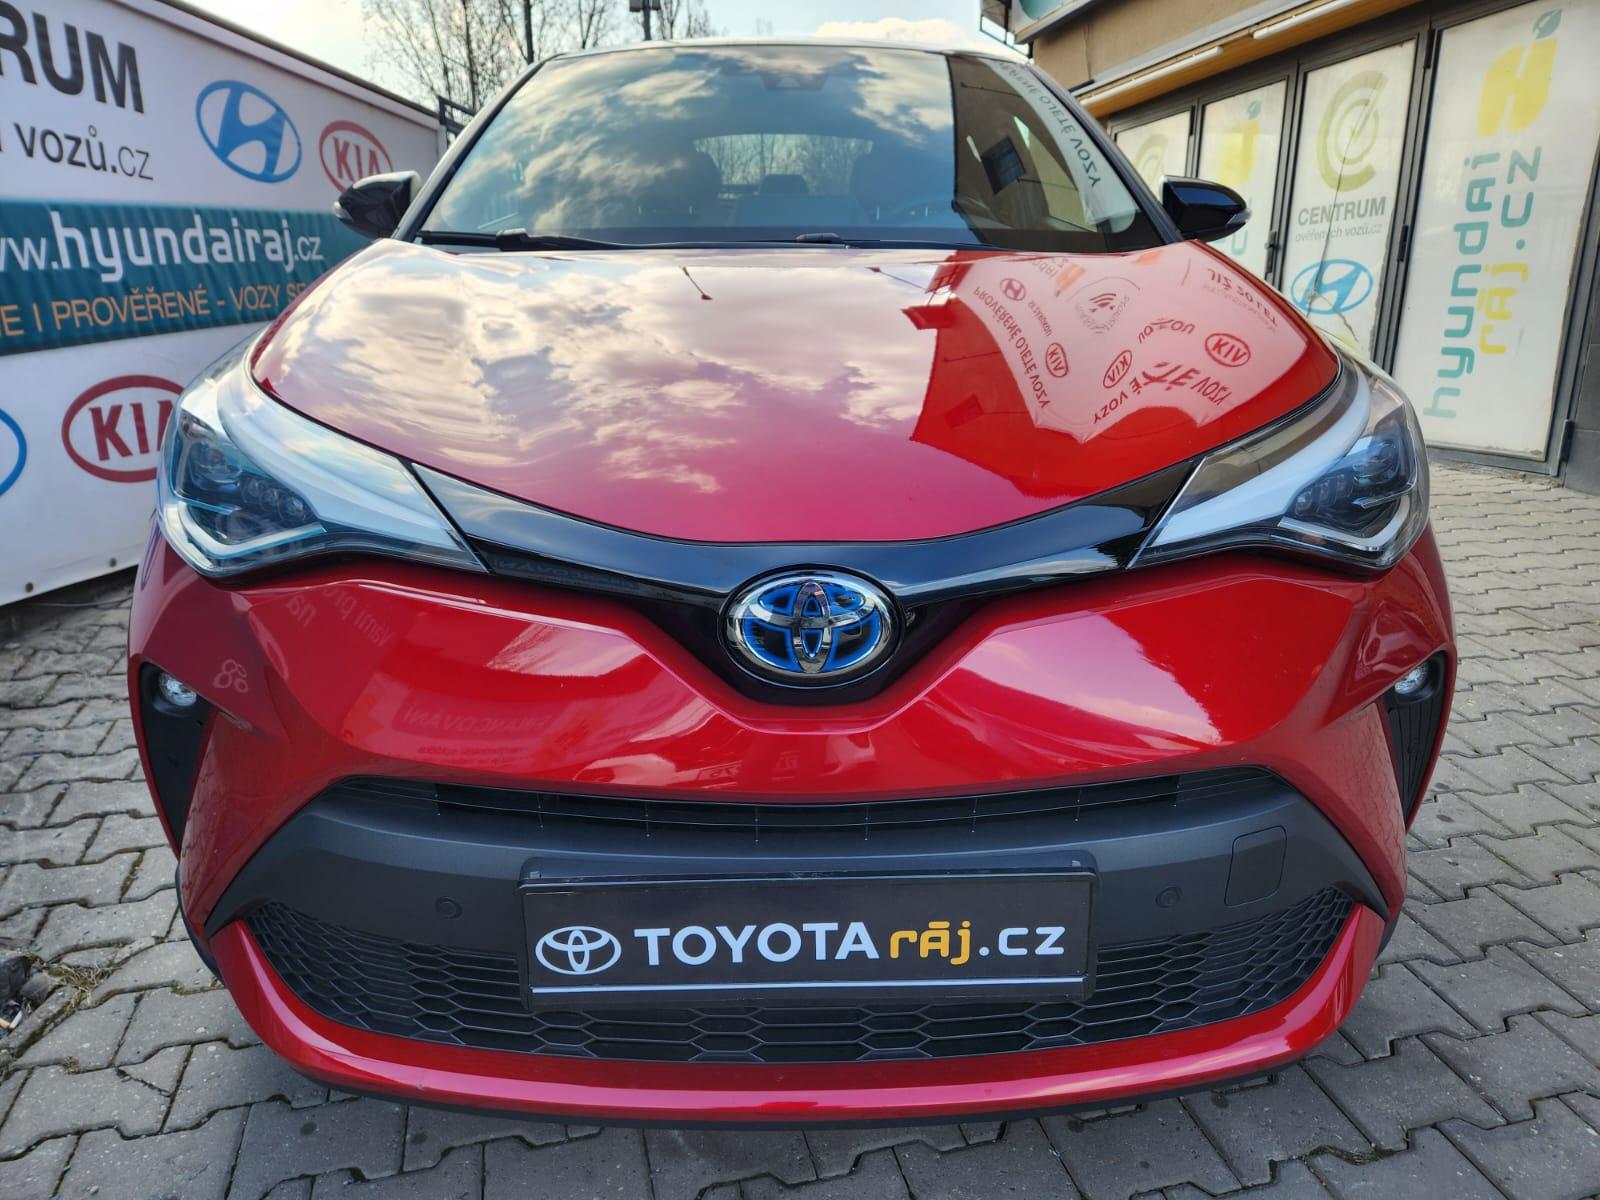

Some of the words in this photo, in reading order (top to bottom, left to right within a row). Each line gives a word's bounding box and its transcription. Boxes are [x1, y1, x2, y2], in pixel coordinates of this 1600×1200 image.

[14, 124, 154, 180] vozů.cz
[1297, 196, 1387, 226] CENTRUM
[53, 284, 211, 330] PROVĚŘENÉ
[229, 285, 281, 311] VOZY
[634, 922, 879, 965] TOYOTA
